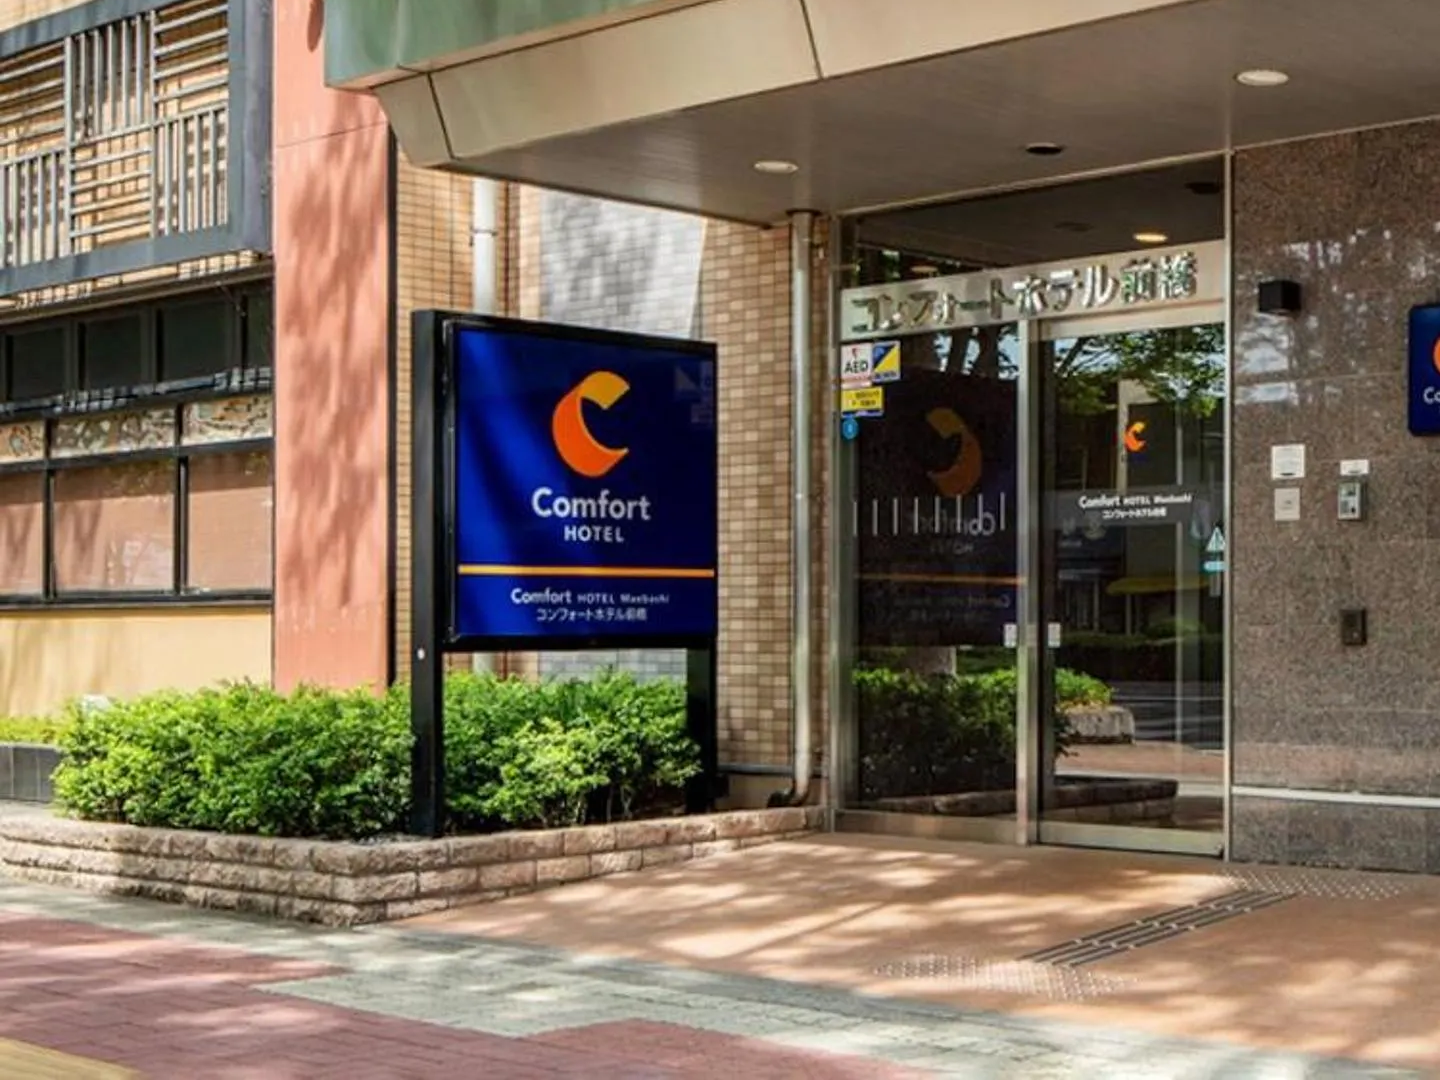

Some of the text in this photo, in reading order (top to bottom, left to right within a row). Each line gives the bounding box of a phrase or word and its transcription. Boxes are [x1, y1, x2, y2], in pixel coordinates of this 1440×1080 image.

[844, 360, 868, 373] AED
[531, 486, 651, 520] Comfort
[1078, 493, 1121, 508] Comfort
[564, 525, 624, 543] HOTEL
[510, 587, 572, 604] Comfort
[577, 593, 615, 605] HOTEL
